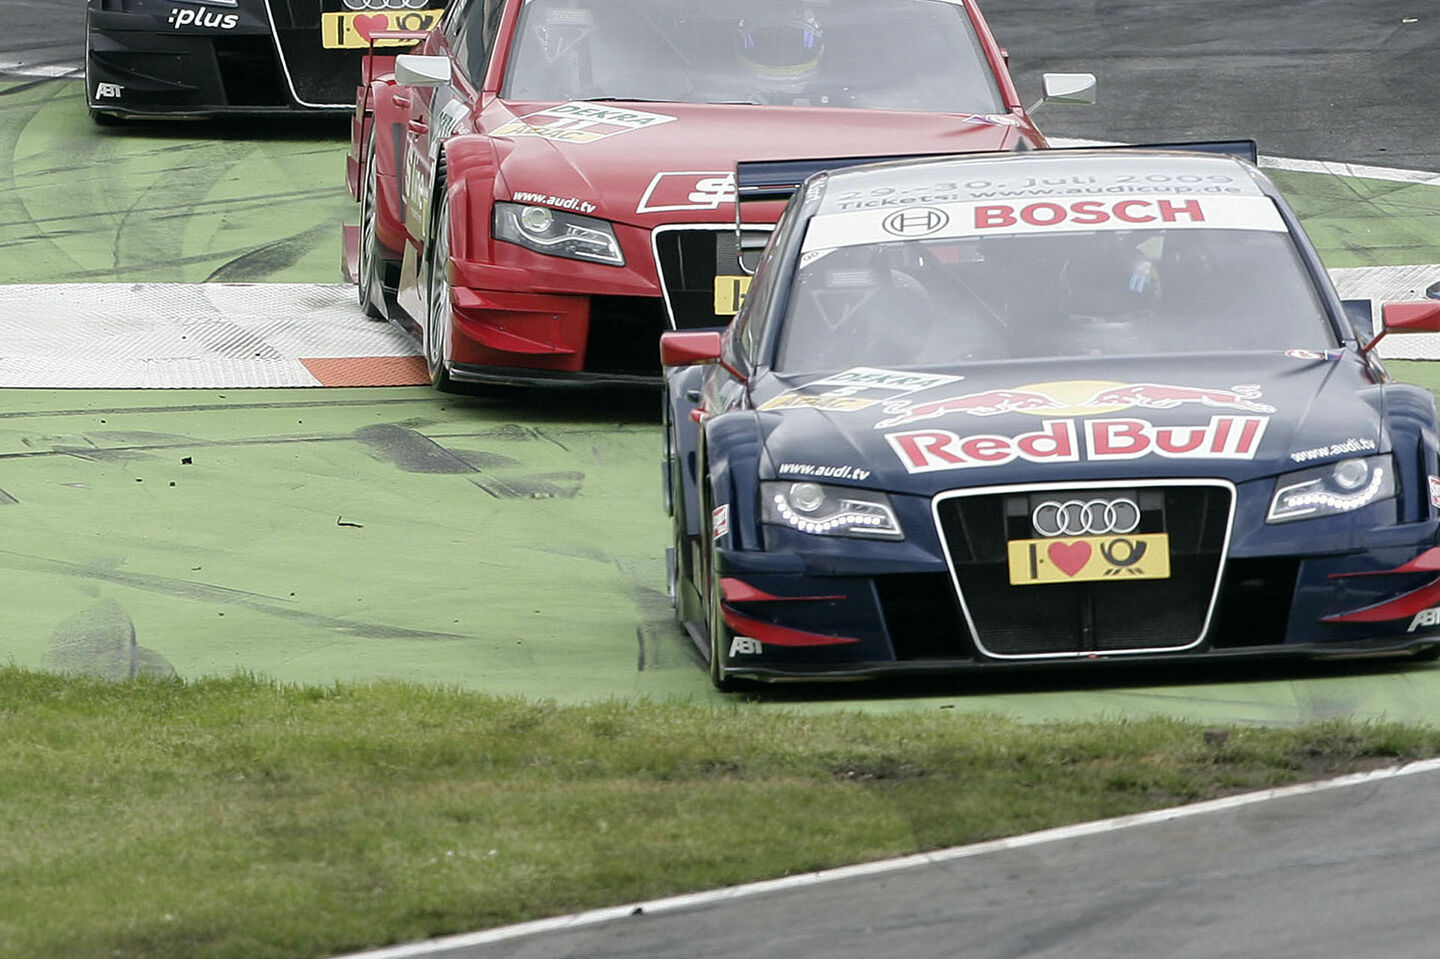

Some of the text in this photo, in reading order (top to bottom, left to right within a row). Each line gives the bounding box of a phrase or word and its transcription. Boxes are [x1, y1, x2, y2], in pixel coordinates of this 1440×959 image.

[549, 105, 656, 125] DEKRA
[1026, 174, 1096, 188] Juli
[1117, 173, 1235, 186] 2009
[512, 190, 597, 215] www.audi.tv
[836, 191, 960, 211] Tickets:
[974, 198, 1206, 229] BOSCH
[892, 418, 1262, 470] Red Bull
[1289, 436, 1377, 465] www.audi.tv
[778, 461, 871, 482] www.audi.tv
